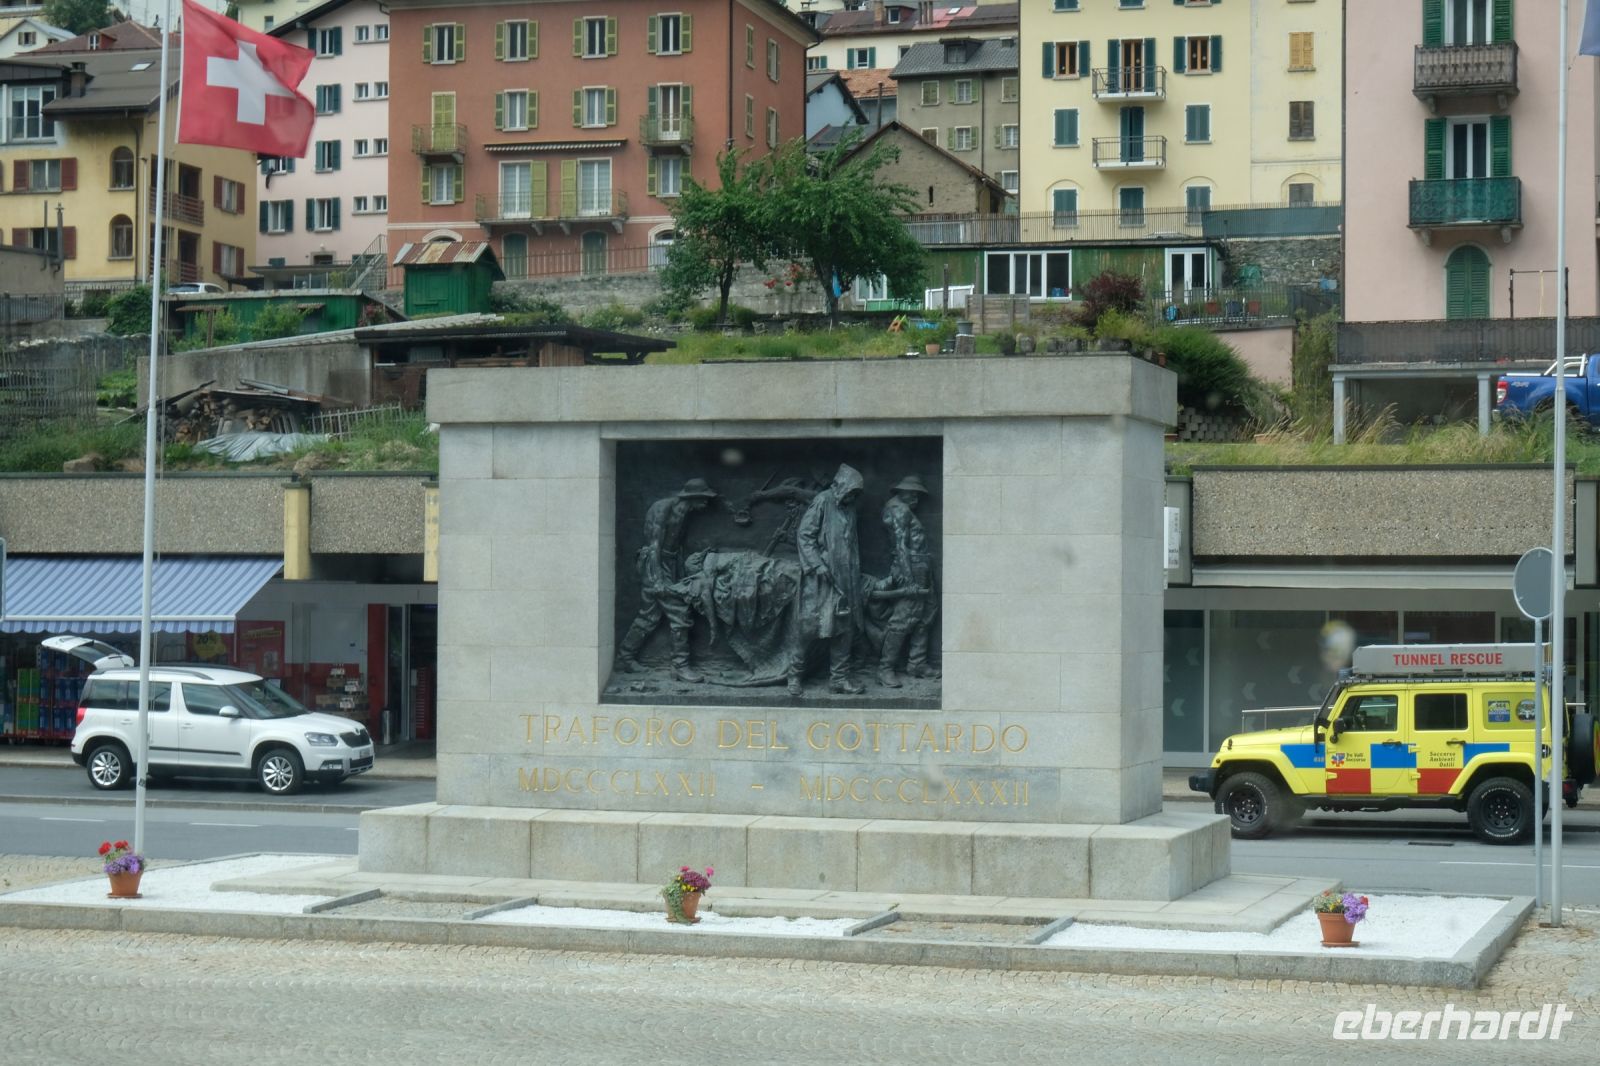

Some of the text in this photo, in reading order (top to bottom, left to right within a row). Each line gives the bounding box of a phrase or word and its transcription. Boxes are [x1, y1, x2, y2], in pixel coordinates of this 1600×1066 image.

[1393, 652, 1503, 666] TUNNEL RESCUE
[519, 714, 1029, 753] TRAFORO DEL GOTTARDO
[518, 767, 717, 797] MDCCCLXXII
[800, 776, 1029, 806] MDCCCLXXXII
